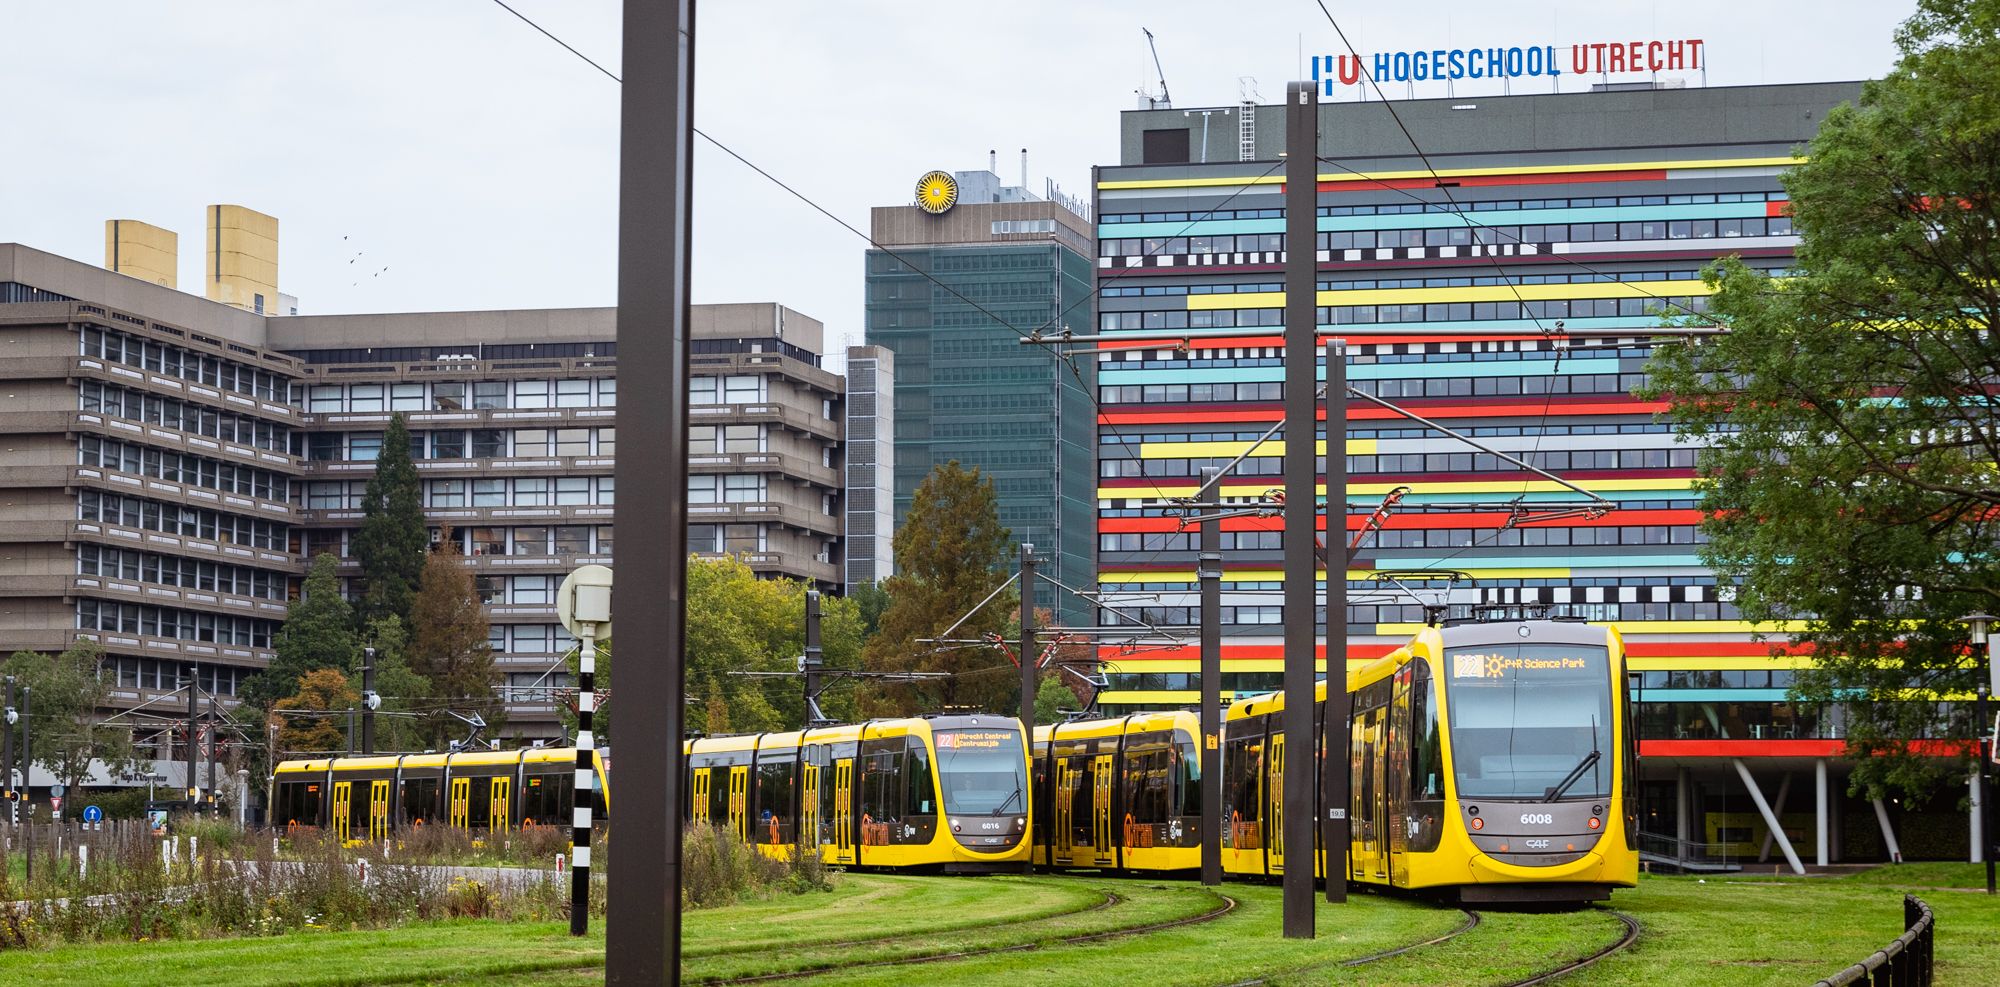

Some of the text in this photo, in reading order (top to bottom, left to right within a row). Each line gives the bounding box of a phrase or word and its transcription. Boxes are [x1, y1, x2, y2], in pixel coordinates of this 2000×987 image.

[1374, 39, 1703, 83] HOGESCHOOL UTRECHT
[1311, 55, 1360, 96] HU
[1459, 655, 1585, 677] 22 P+R Science Park
[939, 735, 952, 747] 22
[1520, 813, 1552, 825] 6008
[981, 822, 1000, 830] 6016
[1525, 839, 1550, 850] CAF
